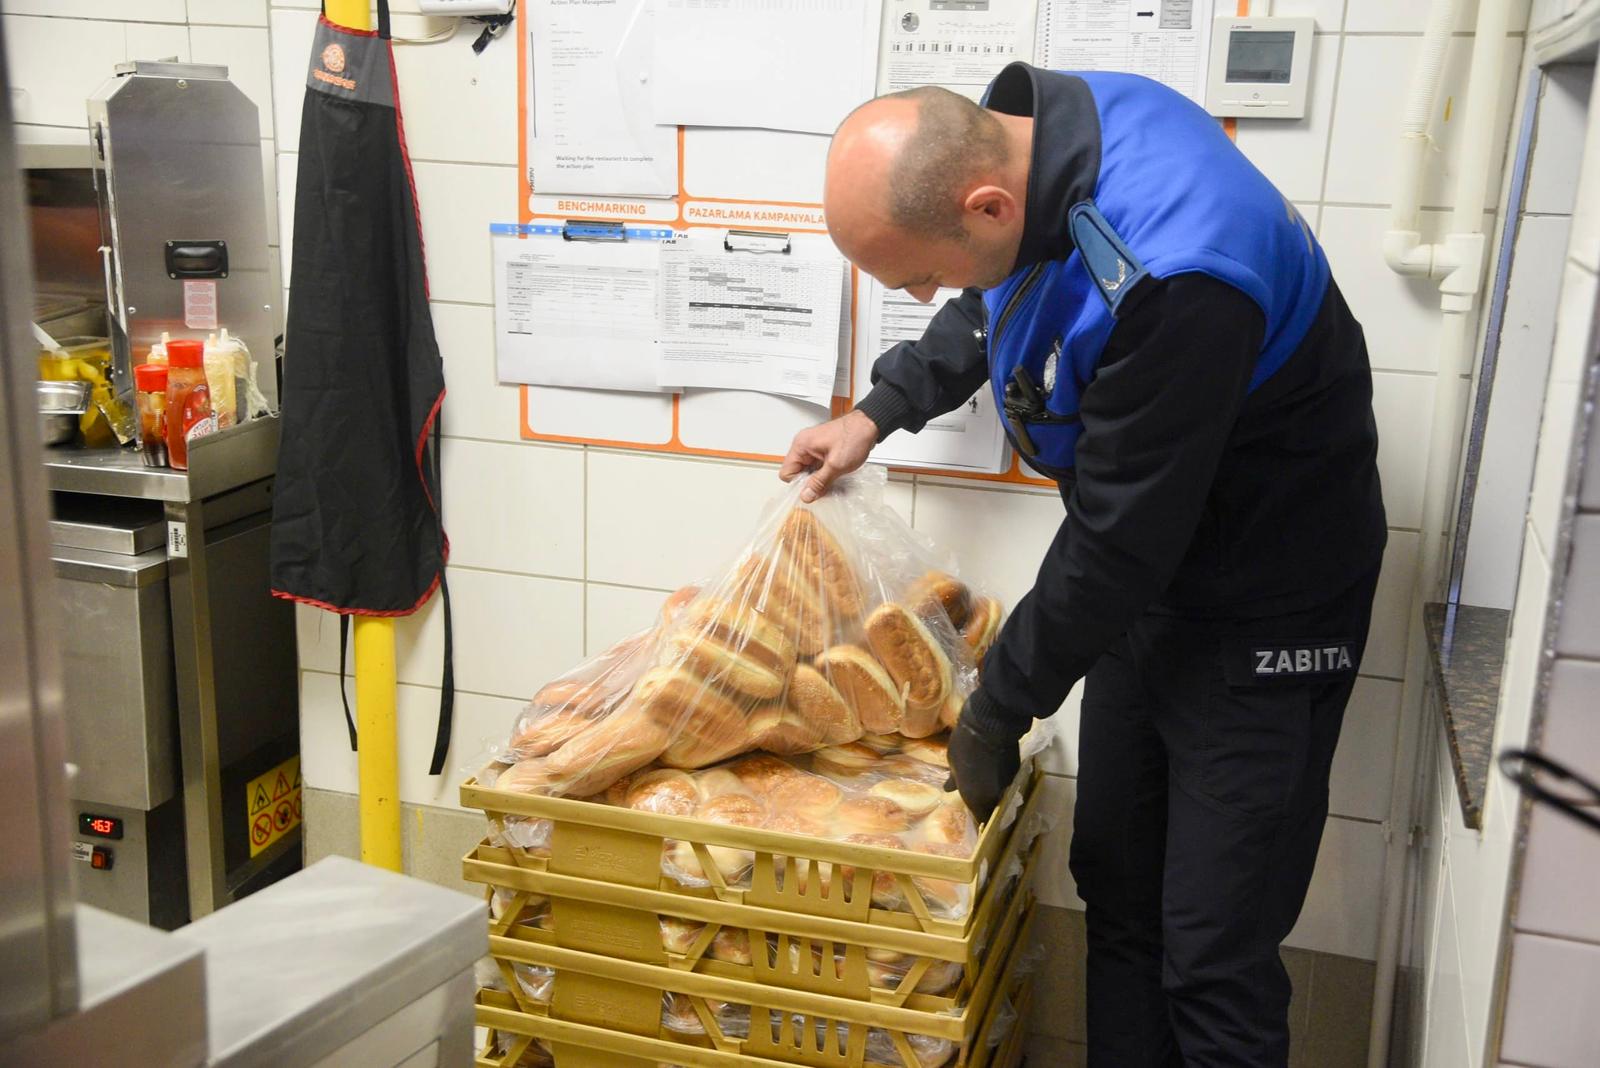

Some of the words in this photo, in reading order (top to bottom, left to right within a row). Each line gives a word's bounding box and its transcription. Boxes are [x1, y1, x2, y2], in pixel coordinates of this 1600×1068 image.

[557, 200, 647, 215] BENCHMARKING
[688, 207, 752, 221] PAZARLAMA
[1255, 646, 1353, 674] ZABITA
